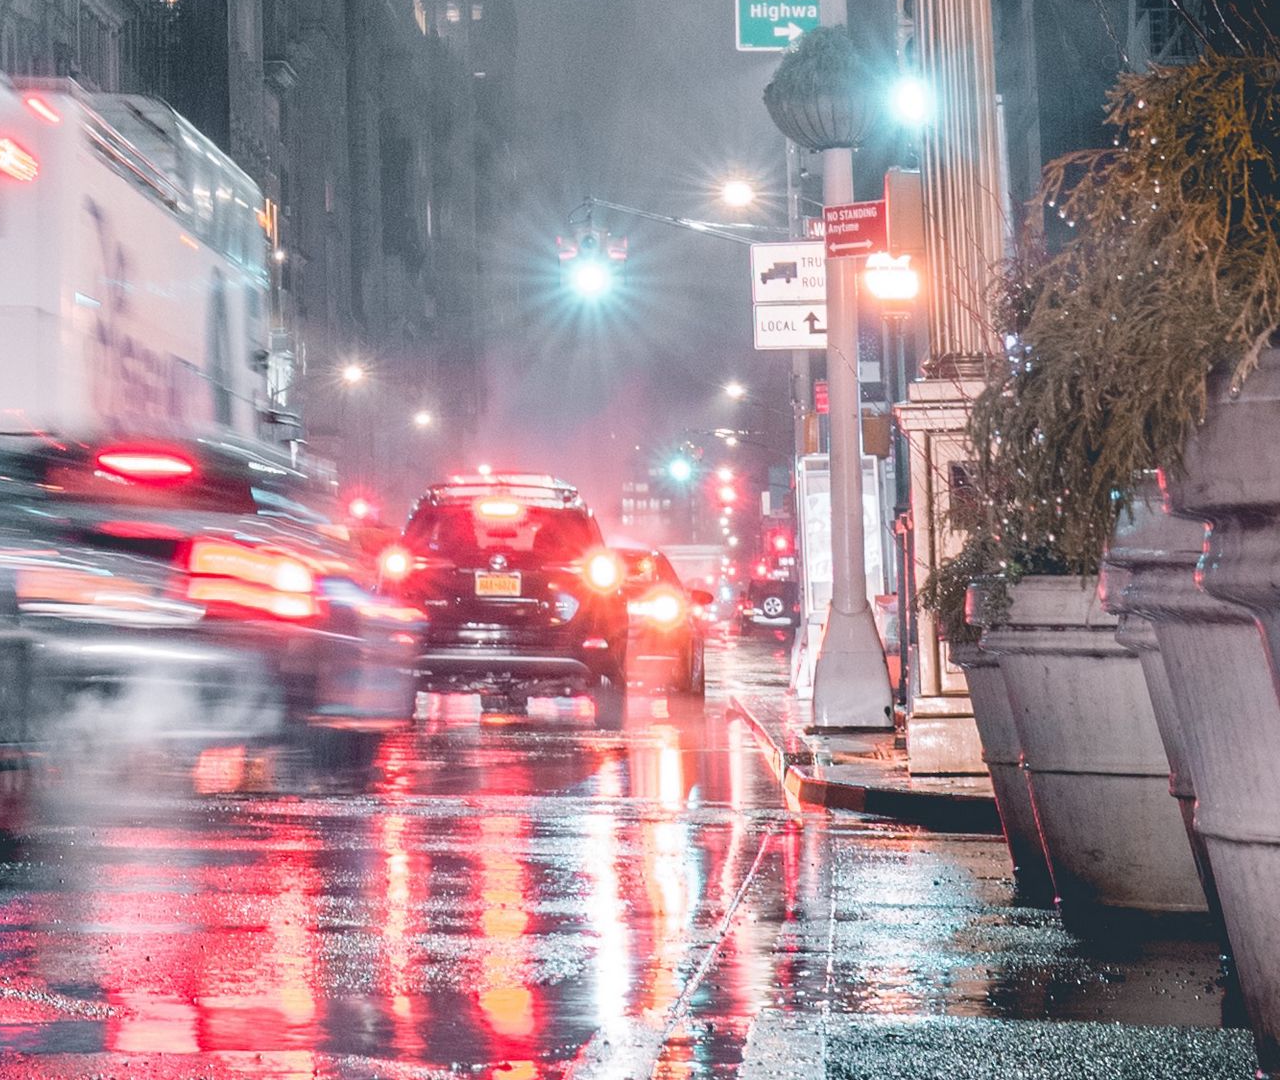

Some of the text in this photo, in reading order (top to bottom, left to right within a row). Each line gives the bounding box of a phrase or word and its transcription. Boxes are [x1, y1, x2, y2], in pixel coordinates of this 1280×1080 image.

[750, 2, 817, 22] Highwa
[826, 207, 878, 221] NO STANDING
[828, 222, 859, 236] Anytime
[801, 256, 825, 268] TRU
[761, 320, 798, 333] LOCAL
